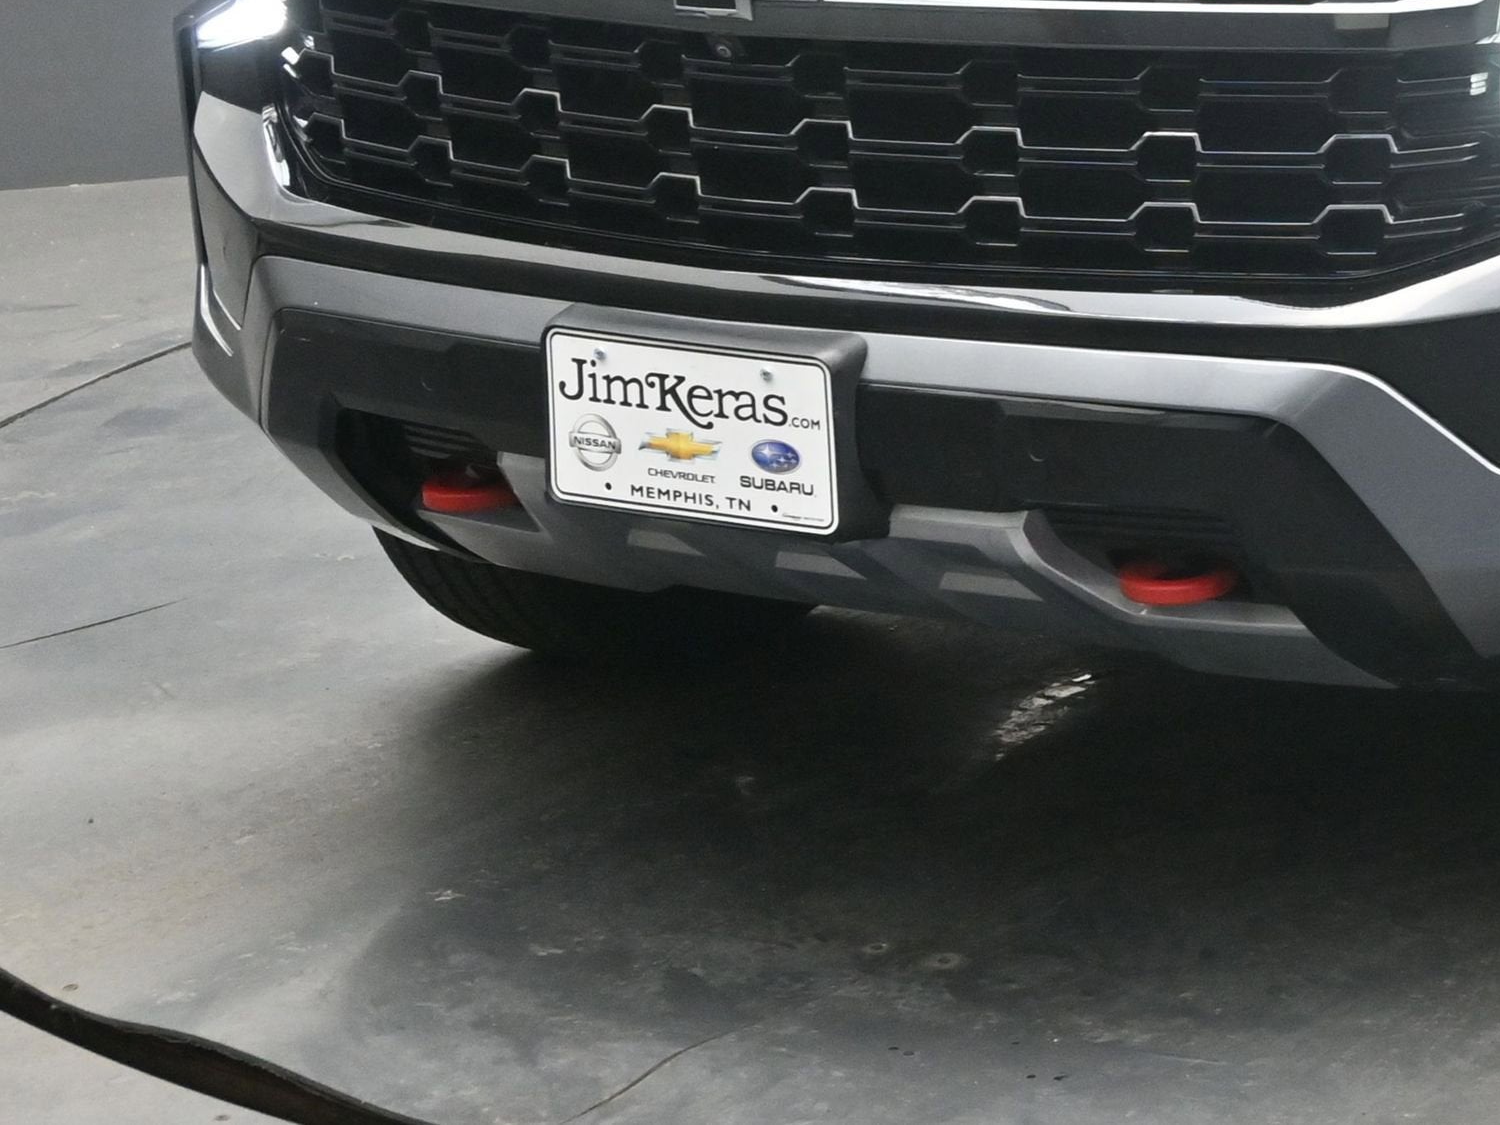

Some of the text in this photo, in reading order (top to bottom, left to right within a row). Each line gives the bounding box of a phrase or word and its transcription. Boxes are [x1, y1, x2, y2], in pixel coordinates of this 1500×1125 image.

[572, 434, 617, 450] NISSAN
[648, 467, 716, 484] CHEVROLET
[739, 475, 814, 496] SUBARU
[630, 484, 751, 512] MEMPHIS, TN
